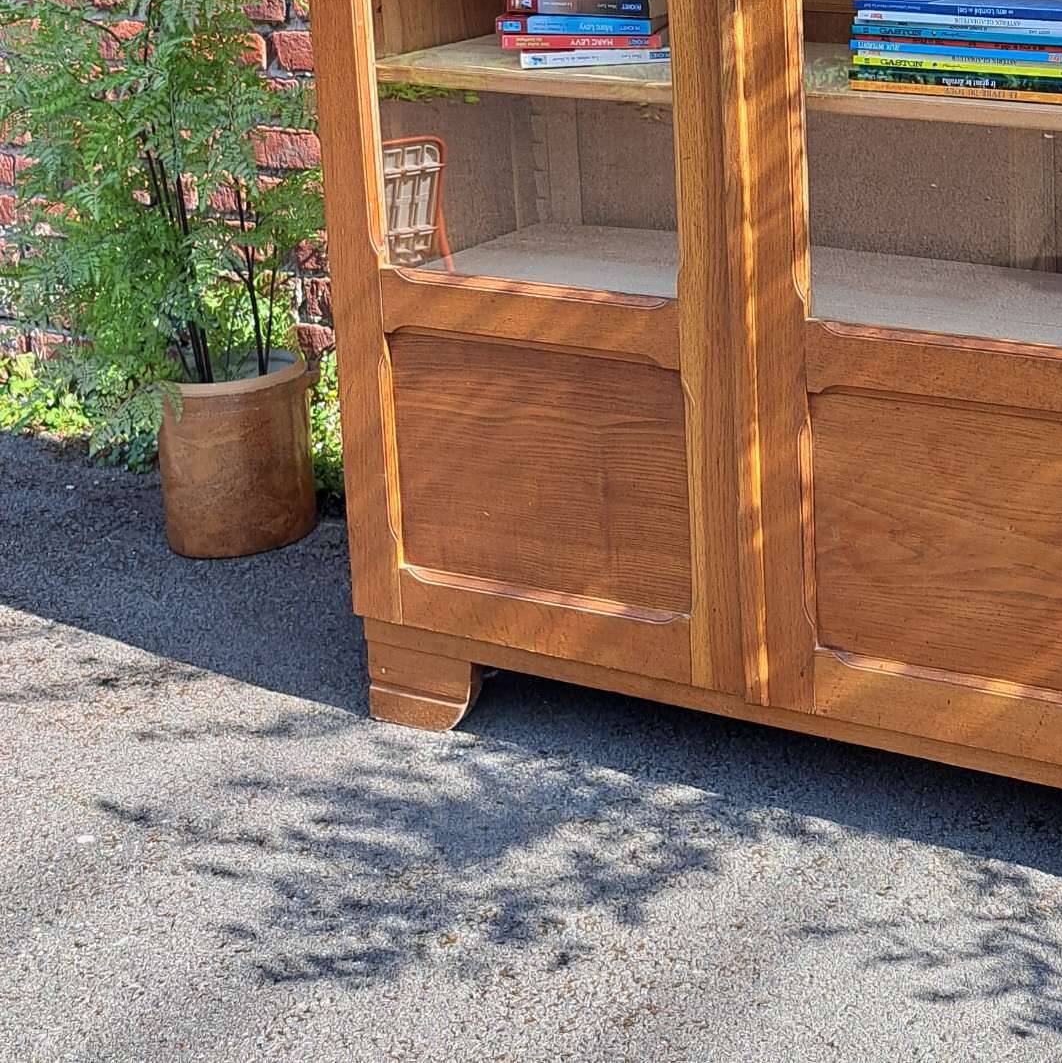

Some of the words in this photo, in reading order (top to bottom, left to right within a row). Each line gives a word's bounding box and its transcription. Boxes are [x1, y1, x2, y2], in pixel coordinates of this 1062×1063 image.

[954, 17, 994, 25] GLADIATEUR
[579, 23, 595, 31] Levy
[879, 28, 922, 36] GASTON
[880, 59, 923, 67] GASTON
[951, 55, 990, 63] GLADIATEUR
